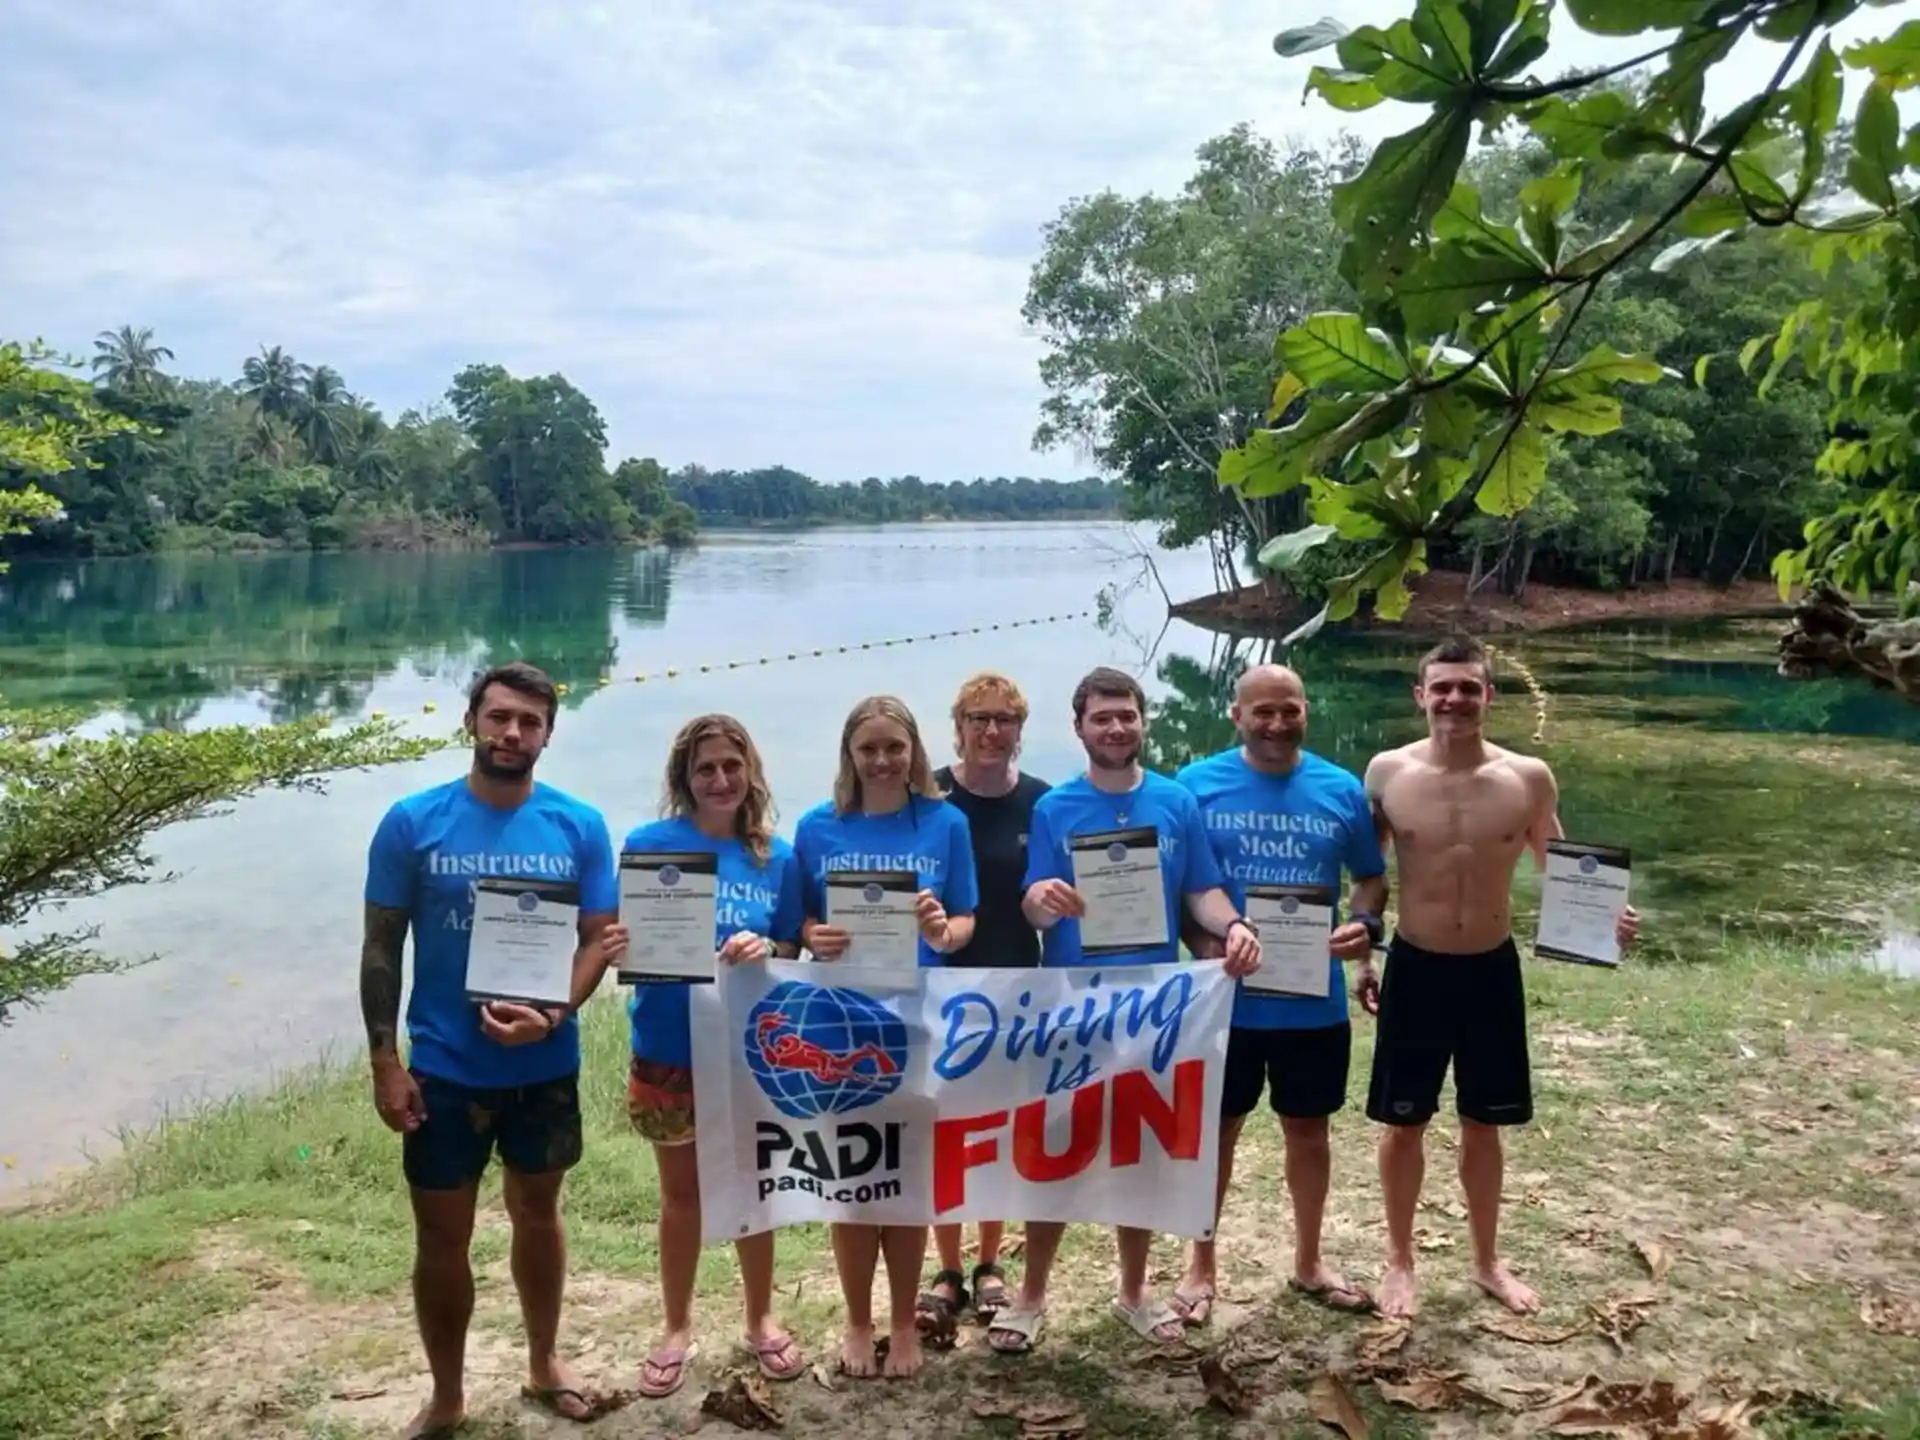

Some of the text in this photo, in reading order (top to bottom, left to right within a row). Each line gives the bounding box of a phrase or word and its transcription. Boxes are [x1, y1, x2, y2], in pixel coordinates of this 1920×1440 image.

[1206, 808, 1340, 838] Instructor
[1239, 834, 1310, 860] Mode
[820, 851, 941, 876] Instructor
[716, 879, 778, 911] uctor
[716, 902, 749, 927] de
[933, 972, 1202, 1081] Diving
[1045, 1039, 1100, 1095] is
[756, 1121, 901, 1181] PADI
[933, 1059, 1206, 1216] FUN
[758, 1175, 901, 1204] padi.com
